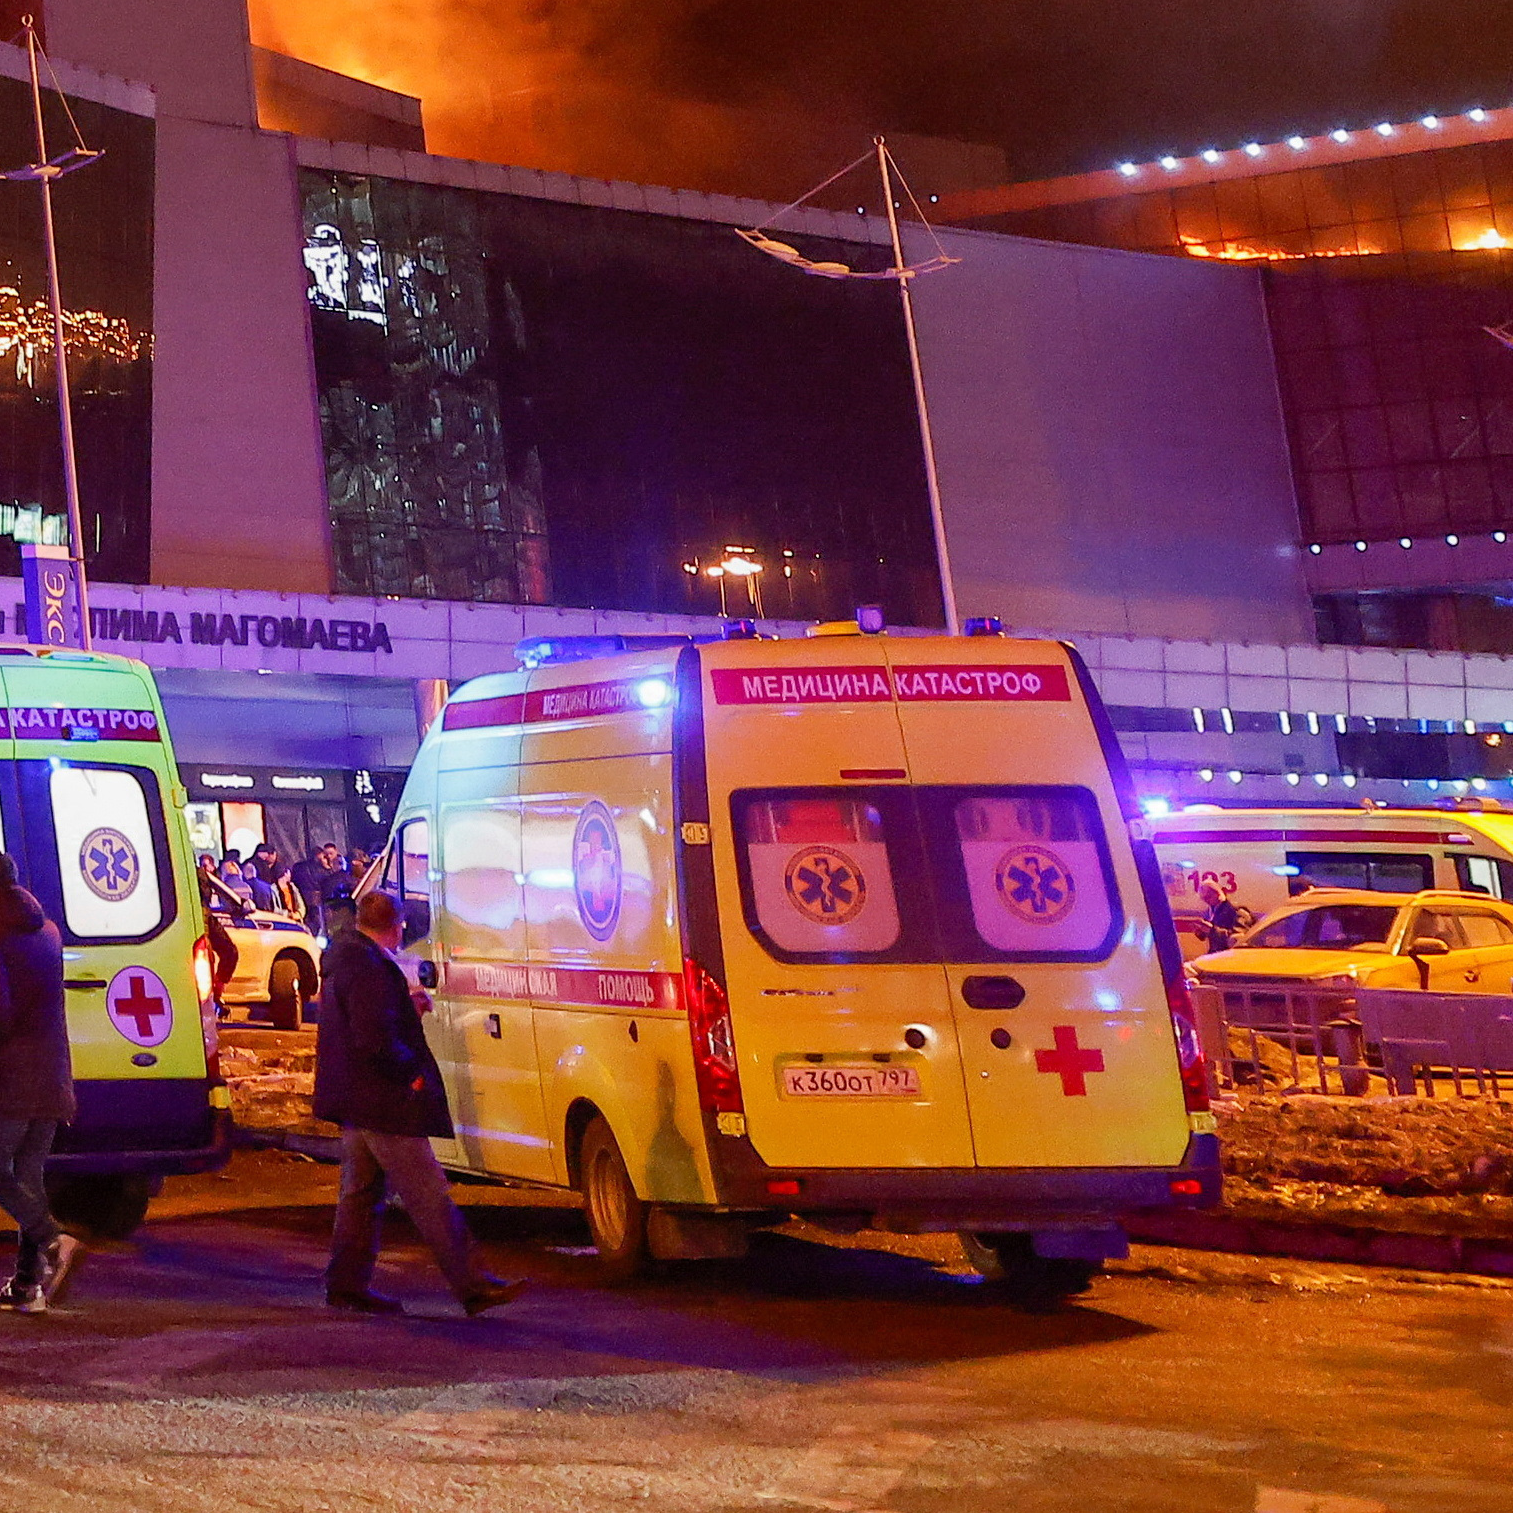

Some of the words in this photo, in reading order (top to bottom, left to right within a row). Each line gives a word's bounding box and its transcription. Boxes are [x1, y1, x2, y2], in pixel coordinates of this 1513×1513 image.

[16, 602, 183, 644] ЛИМА
[190, 611, 393, 654] МАГОМАЕВА
[742, 673, 890, 702] МЕДИЦИНА
[894, 671, 1042, 696] КАТАСТРОФ
[11, 707, 158, 731] КАТАСТРОФ
[597, 974, 655, 1007] ПОМОЩЬ
[792, 1071, 873, 1092] К360ОТ
[878, 1070, 910, 1086] 797
